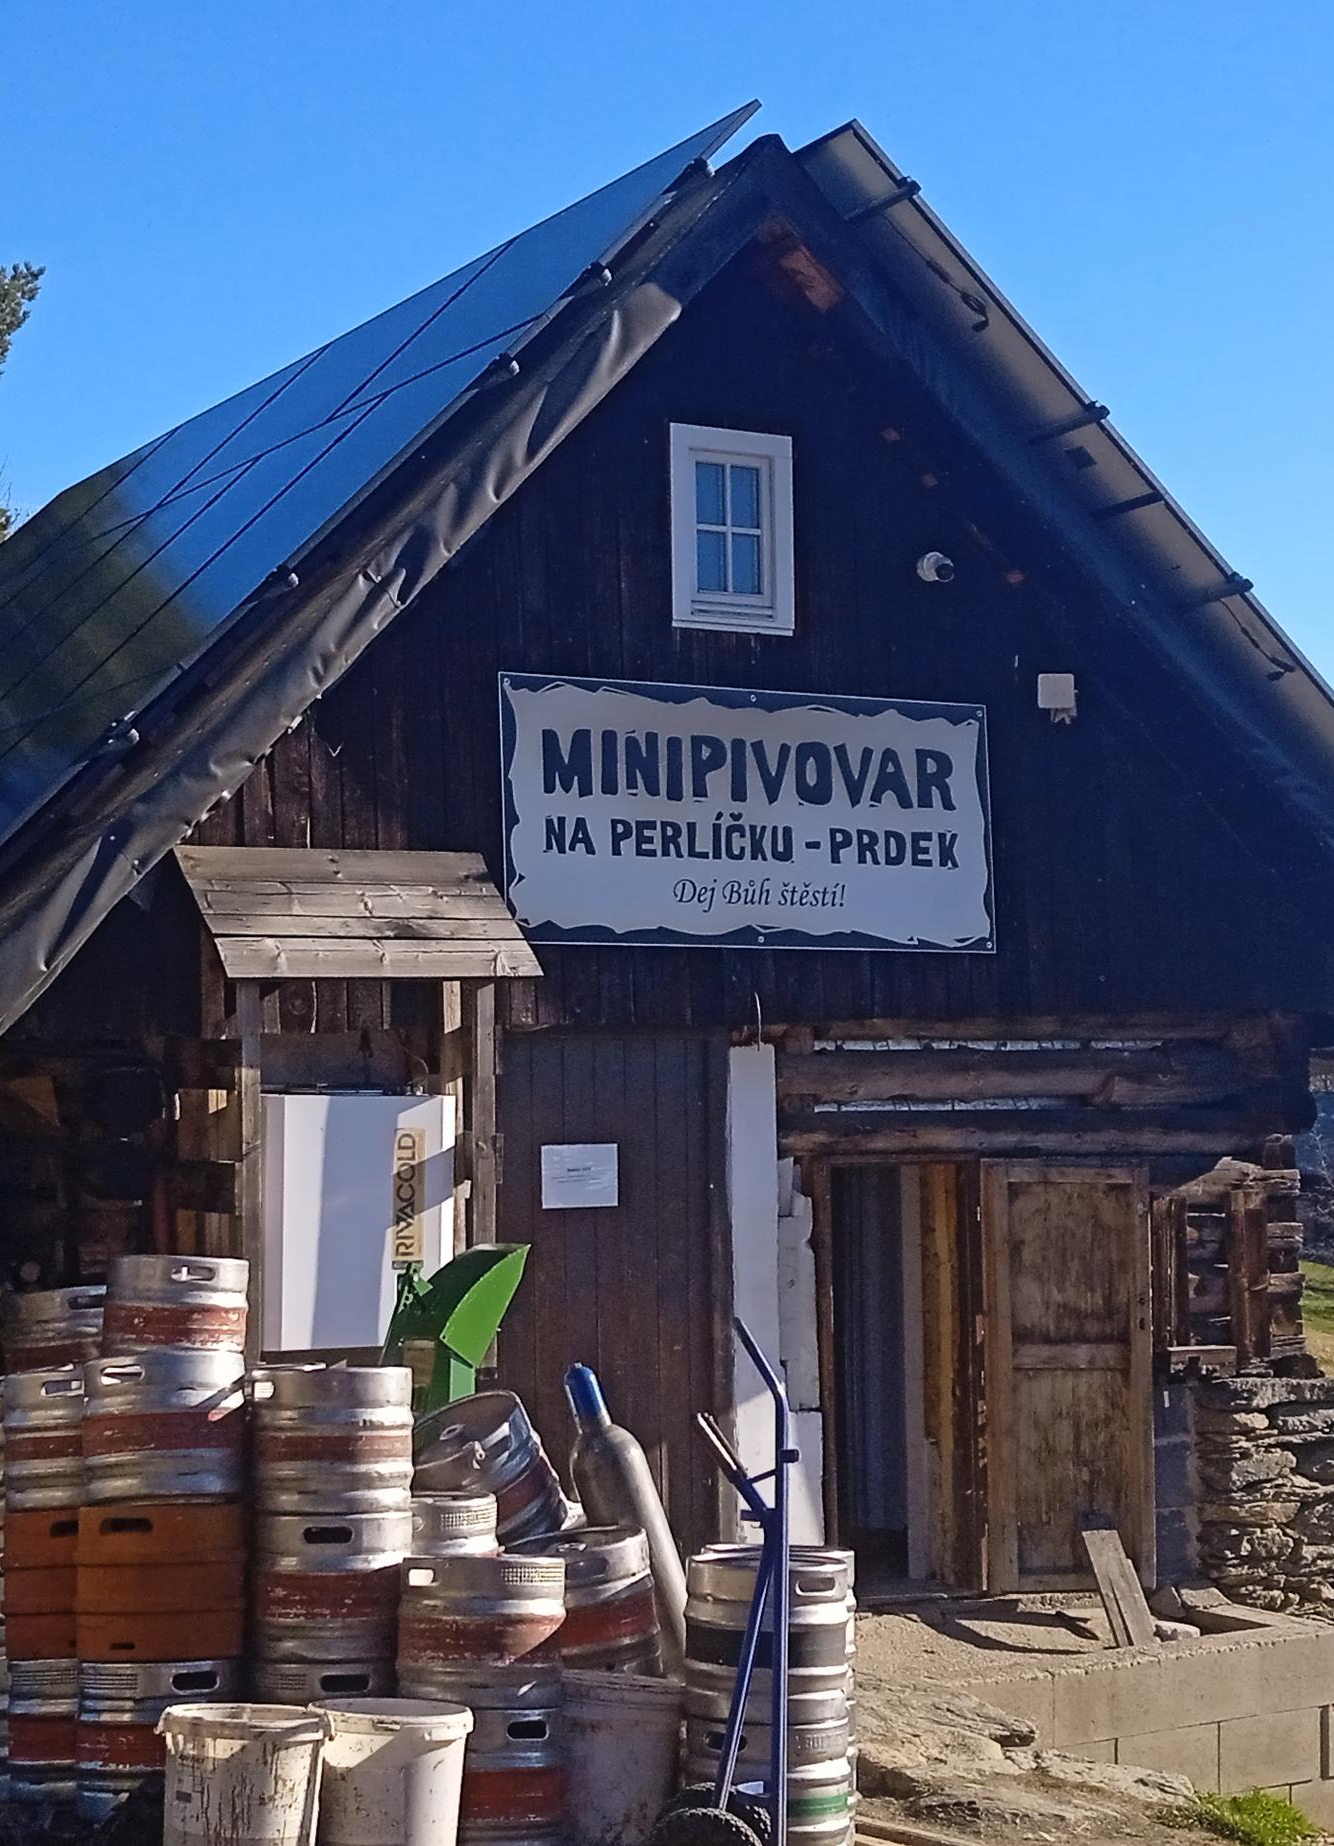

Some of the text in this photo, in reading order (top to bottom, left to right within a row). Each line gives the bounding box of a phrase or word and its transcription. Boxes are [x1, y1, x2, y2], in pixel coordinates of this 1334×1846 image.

[542, 728, 957, 811] MINIPIVOVAR
[543, 815, 596, 855] NA
[610, 811, 795, 863] PERLÍČKU
[829, 827, 960, 870] PRDEK
[672, 876, 846, 913] Dej Bůh štěstí!
[395, 1132, 416, 1257] RIVACOLD
